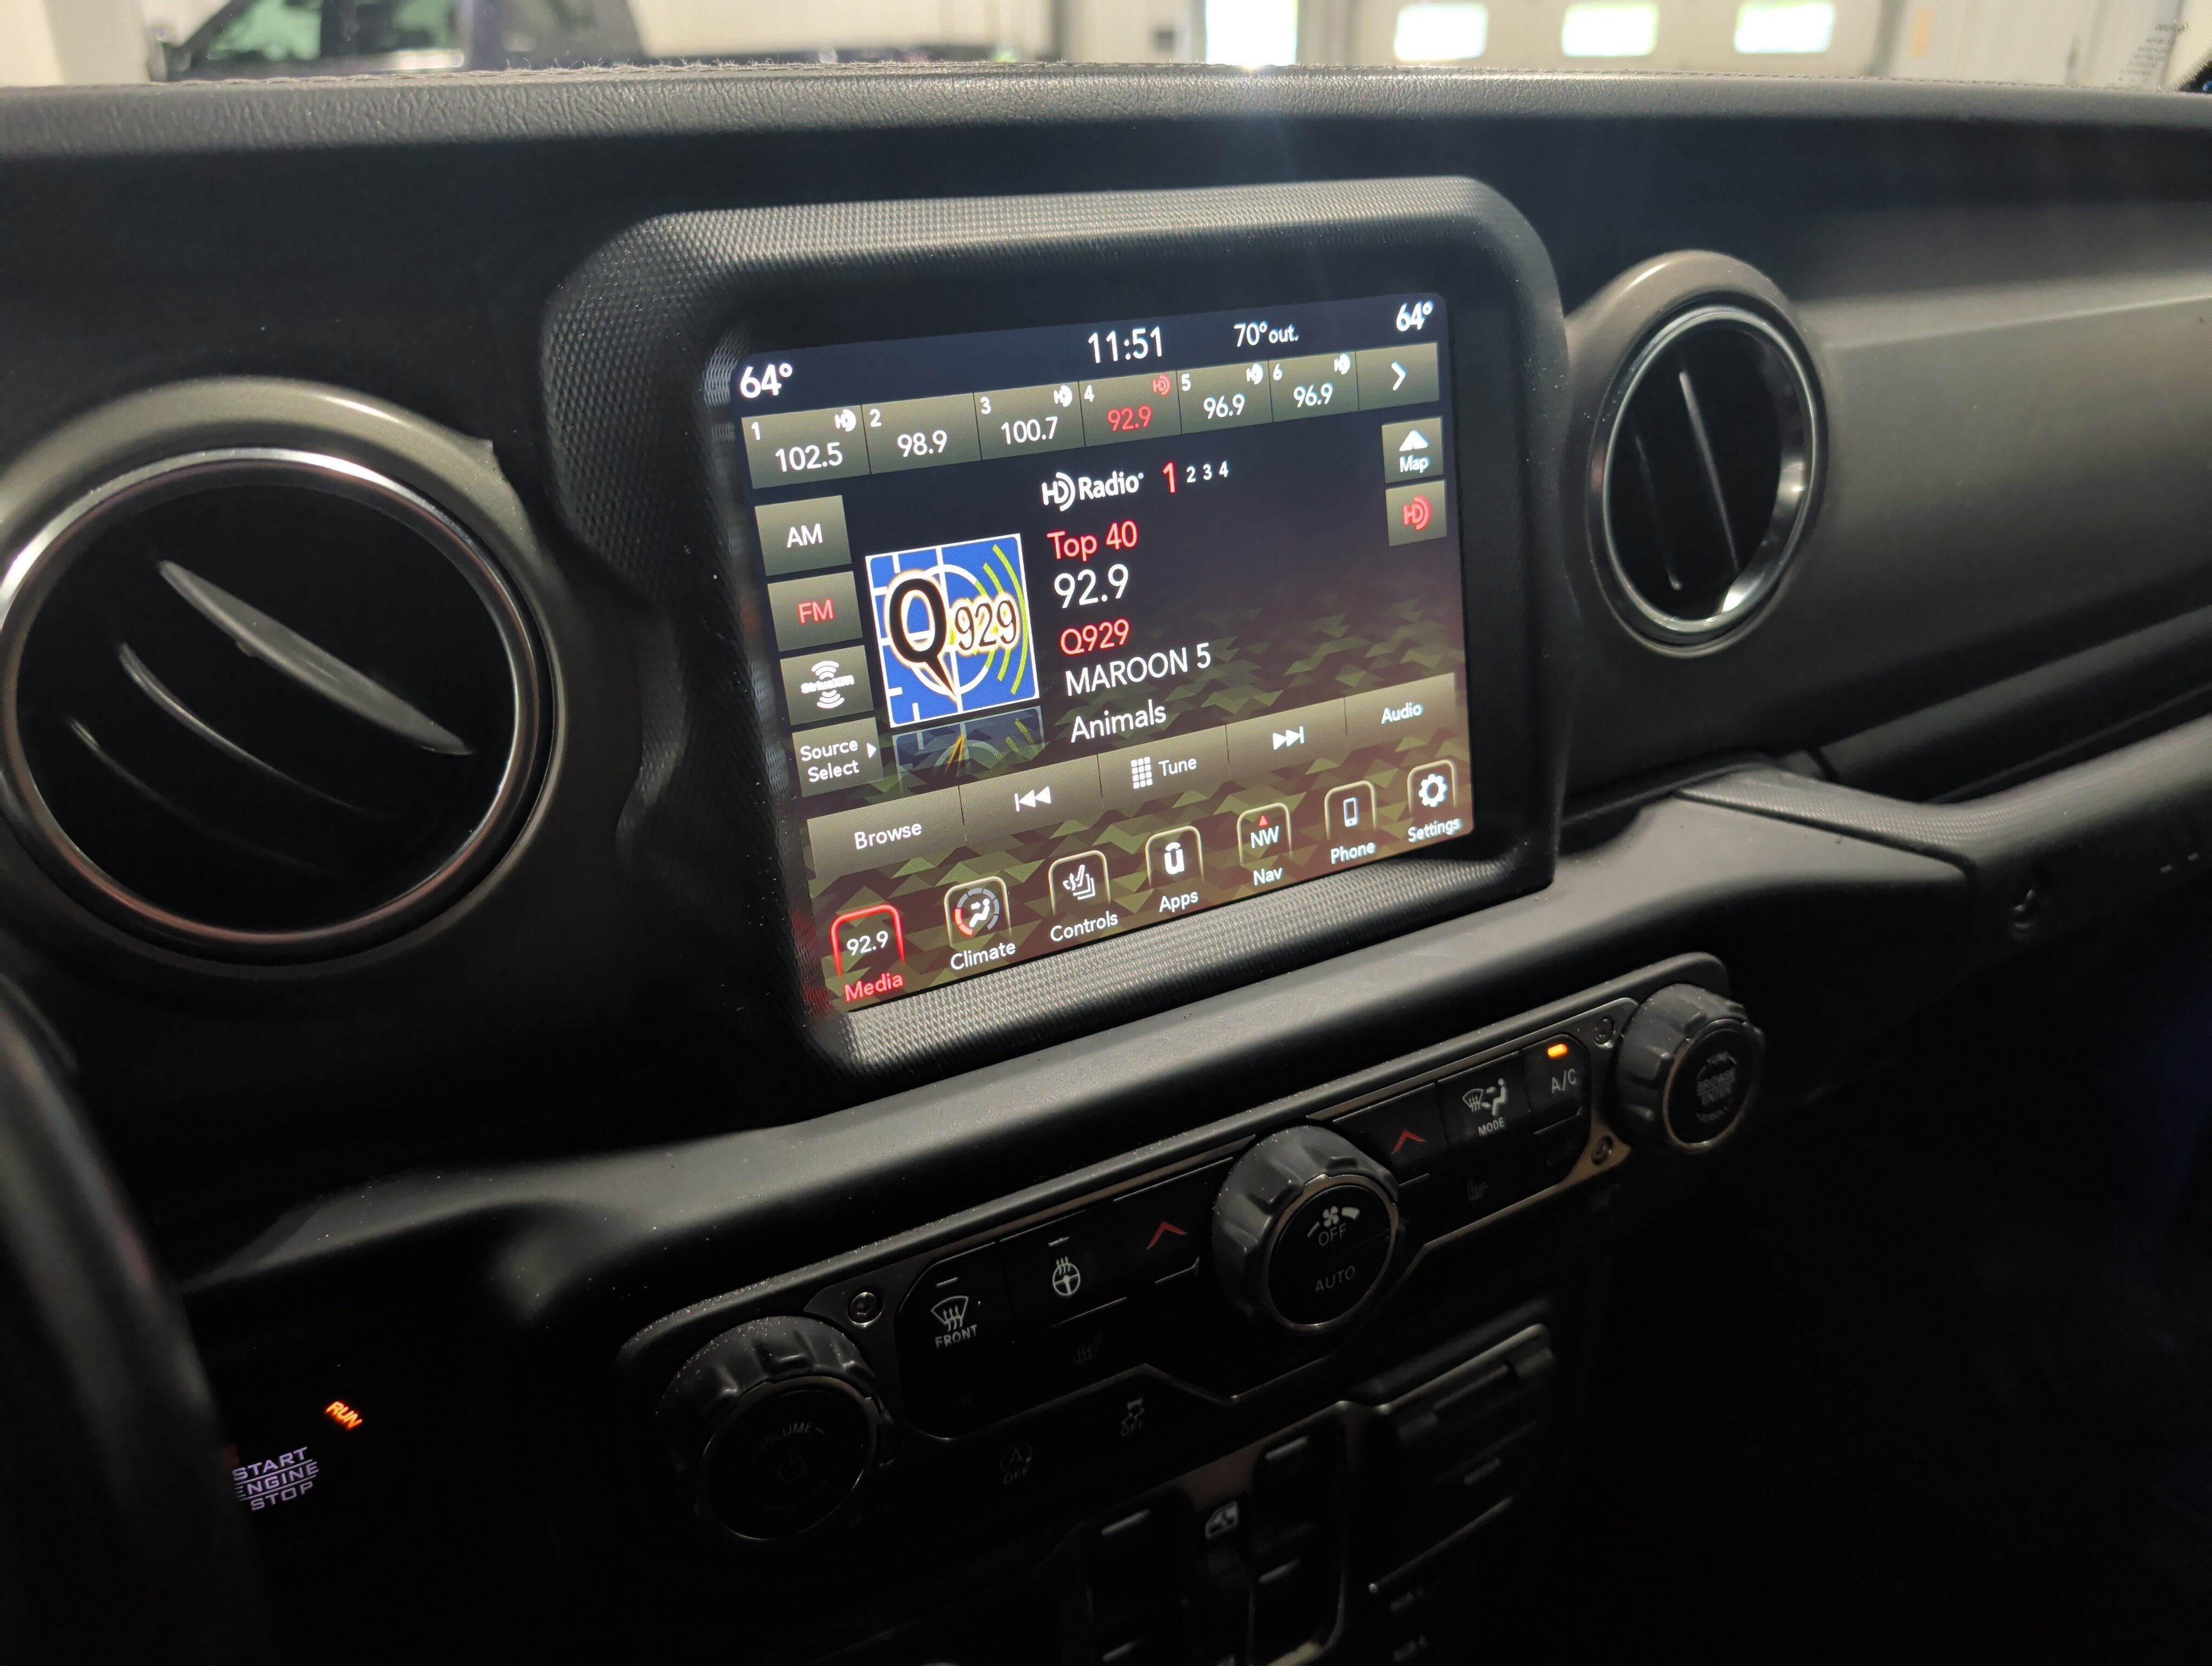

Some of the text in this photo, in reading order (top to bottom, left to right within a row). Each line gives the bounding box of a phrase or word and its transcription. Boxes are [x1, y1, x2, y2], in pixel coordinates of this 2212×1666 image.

[1396, 302, 1433, 331] 64°
[1088, 326, 1162, 364] 11:51
[740, 363, 793, 399] 64°
[1181, 373, 1192, 392] 5
[1272, 363, 1283, 381] 6
[980, 396, 992, 415] 3
[1084, 384, 1095, 403] 4
[1203, 393, 1245, 420] 96.9
[1293, 383, 1333, 408] 96.9
[751, 421, 761, 441] 1
[869, 408, 883, 428] 2
[1001, 415, 1058, 445] 100.7
[1107, 405, 1152, 432] 92.9
[775, 441, 843, 472] 102.5
[897, 430, 948, 458] 98.9
[1162, 461, 1229, 494] 1 2 3 4
[1399, 454, 1430, 474] Map
[1078, 470, 1140, 501] Radio
[786, 522, 824, 549] AM
[1047, 520, 1138, 562] Top 40
[1053, 563, 1129, 609] 92.9
[798, 599, 834, 624] FM
[1060, 618, 1130, 656] Q929
[1064, 642, 1211, 697] MAROON 5
[1070, 699, 1167, 744] Animals
[1380, 701, 1424, 725] Audio
[800, 736, 859, 764] Source
[807, 759, 860, 783] Select
[1158, 757, 1198, 777] Tune
[854, 822, 923, 850] Browse
[1250, 825, 1280, 849] NW
[1407, 818, 1461, 843] Settings
[1330, 840, 1376, 864] Phone
[1252, 867, 1283, 887] Nav
[1159, 889, 1199, 913] Apps
[1050, 911, 1118, 943] Controls
[846, 930, 889, 956] 92.9
[950, 941, 1017, 971] Climate
[844, 972, 904, 1002] Media
[1551, 1068, 1577, 1094] A/C
[1477, 1116, 1506, 1137] MODE
[1318, 1222, 1347, 1246] OFF
[1314, 1265, 1355, 1293] AUTO
[935, 1323, 978, 1349] FRONT
[324, 1400, 363, 1430] RUN
[232, 1446, 308, 1481] START
[249, 1481, 314, 1511] STOP
